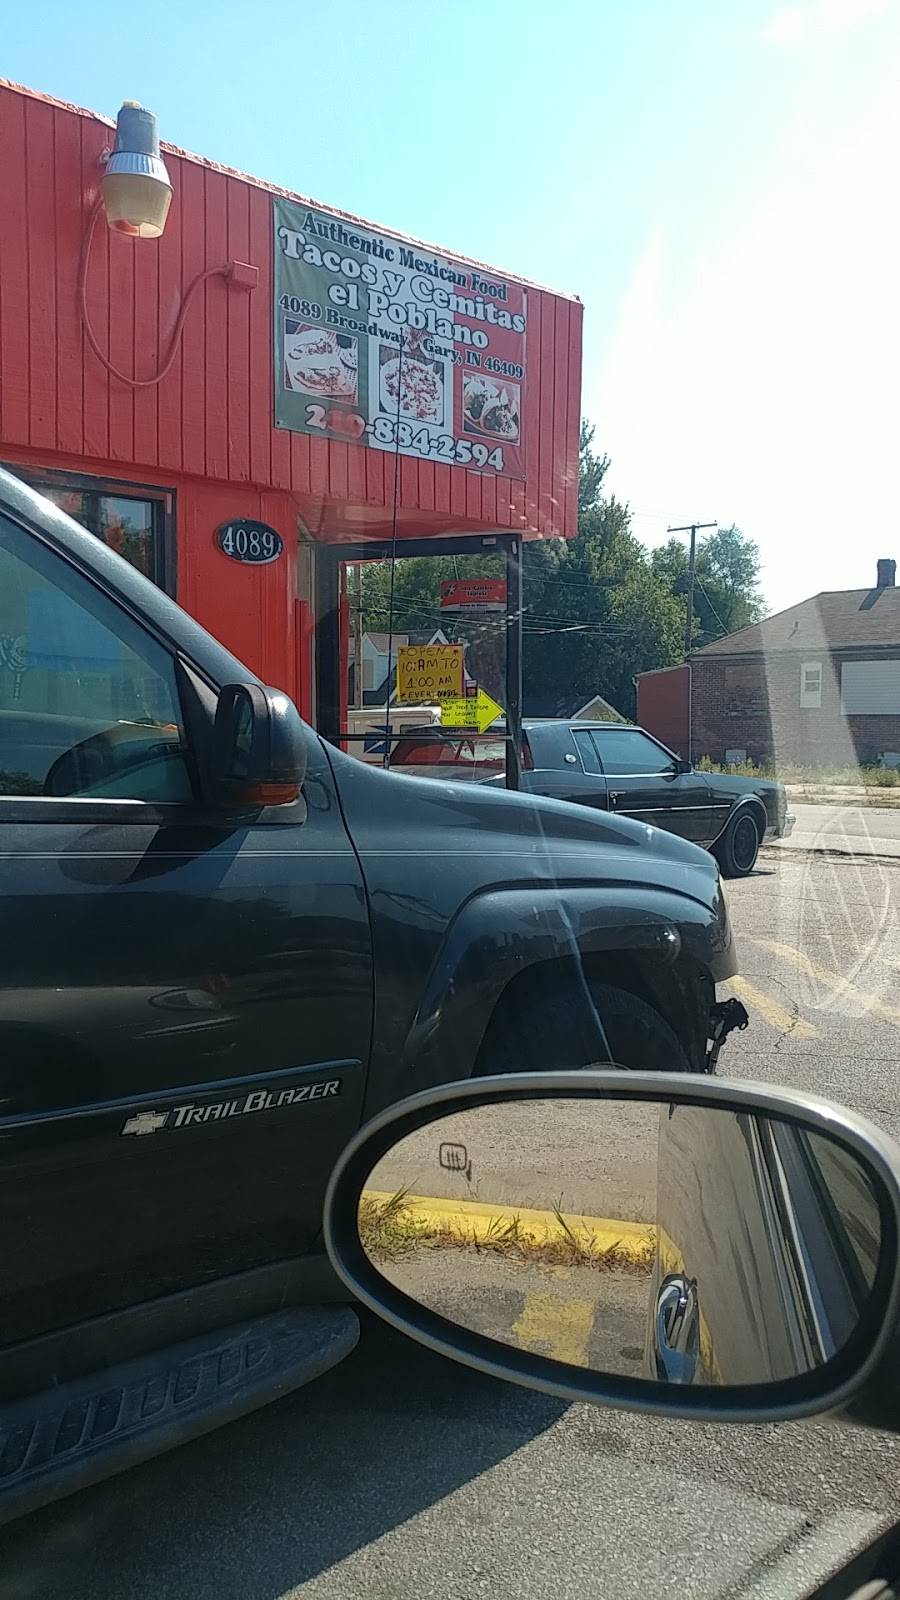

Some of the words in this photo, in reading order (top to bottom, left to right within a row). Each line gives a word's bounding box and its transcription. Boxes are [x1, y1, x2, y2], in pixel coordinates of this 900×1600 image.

[277, 225, 377, 285] Tacos
[382, 270, 405, 298] y
[410, 275, 525, 334] Cemitas
[303, 212, 395, 262] Authentic
[398, 246, 467, 287] Mexican
[470, 272, 507, 302] Food
[280, 294, 321, 320] 4089
[423, 337, 462, 366] Gary,
[465, 350, 481, 367] IN
[484, 357, 523, 379] 46409
[328, 283, 360, 311] el
[366, 288, 489, 350] Poblano
[305, 403, 505, 471] 2-884-2594
[222, 526, 275, 557] 4089
[407, 647, 447, 657] OPEN
[440, 658, 459, 670] TO
[172, 1079, 340, 1128] TRAILBLAZER
